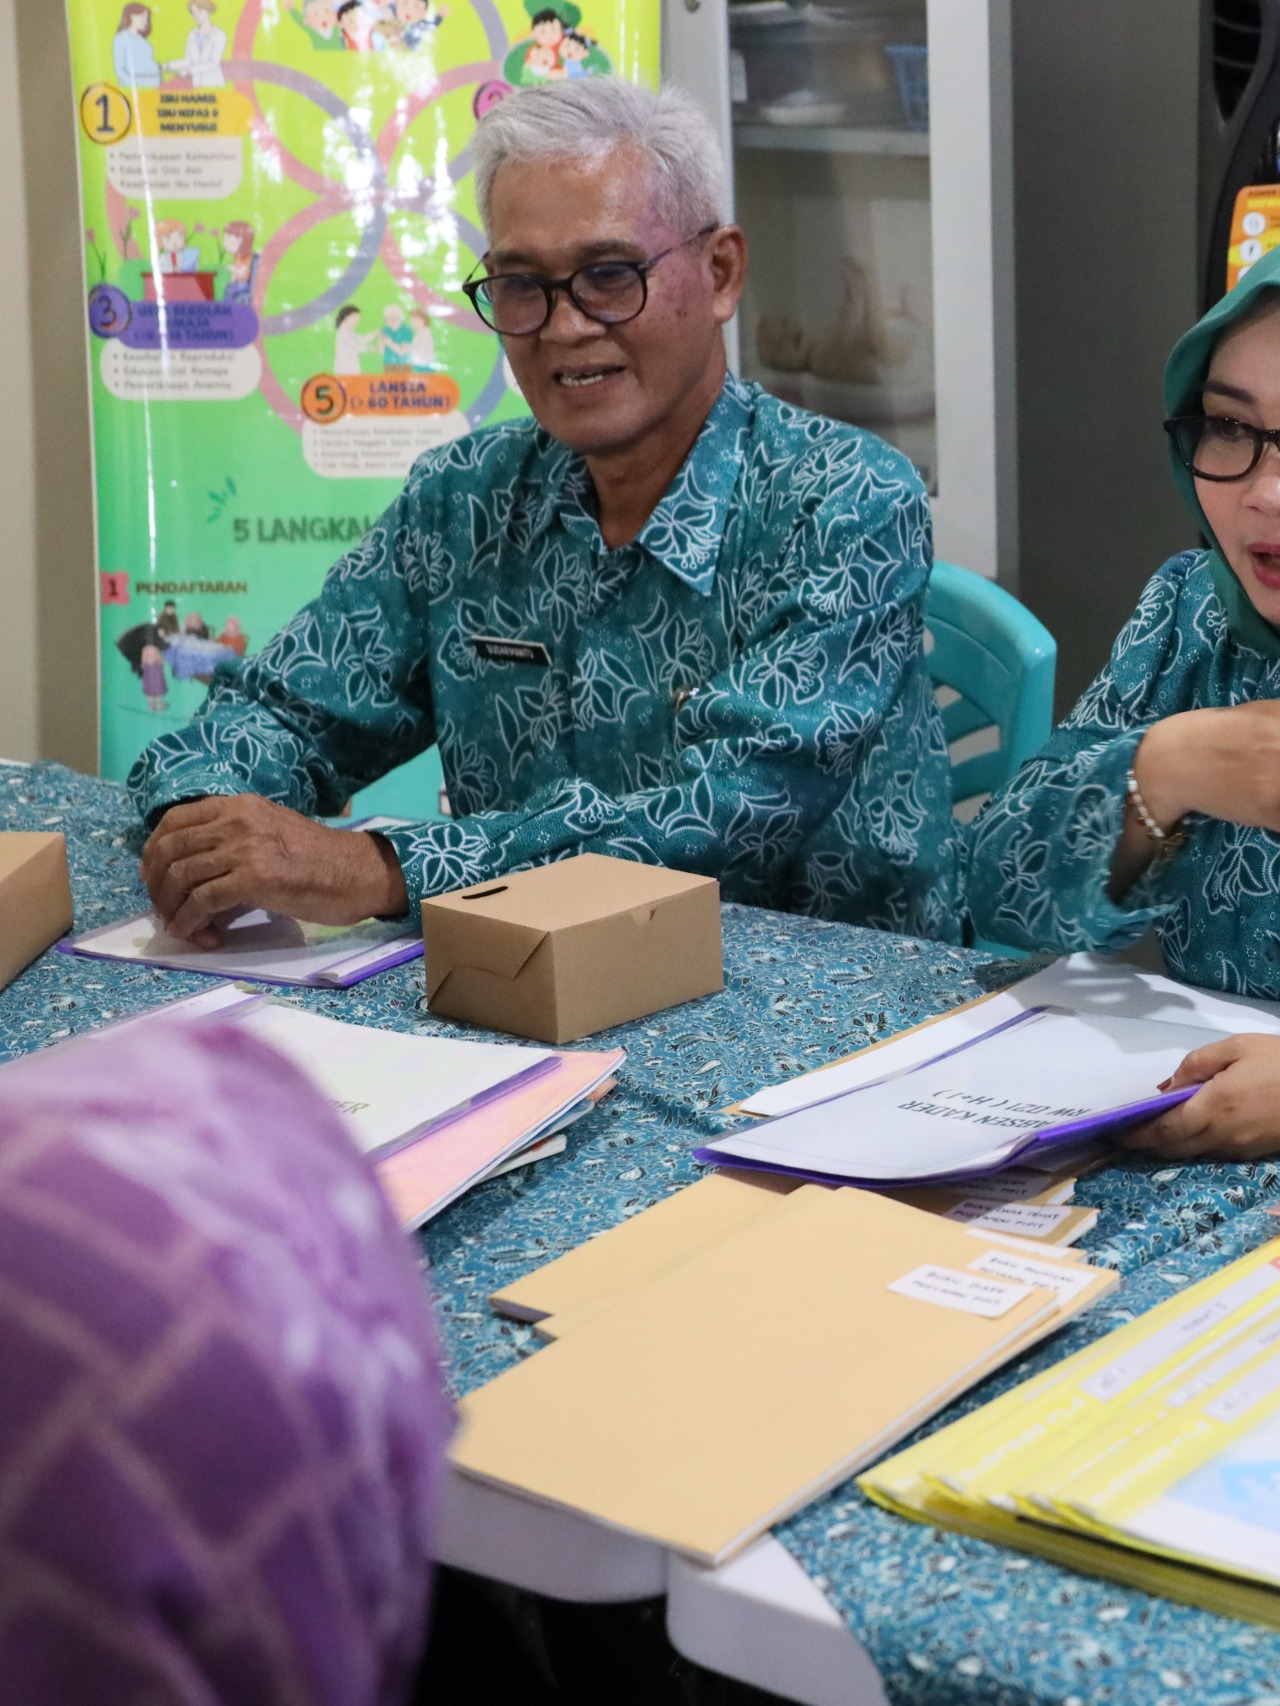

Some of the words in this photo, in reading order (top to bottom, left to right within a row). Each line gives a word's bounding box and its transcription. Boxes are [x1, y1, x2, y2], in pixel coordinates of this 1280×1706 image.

[96, 94, 115, 133] 1
[99, 295, 117, 327] 3
[369, 381, 426, 393] LANSIA
[315, 386, 335, 415] 5
[368, 397, 388, 409] 60
[232, 517, 250, 543] 5
[108, 579, 119, 597] 1
[136, 581, 247, 595] PENDAFTARAN
[897, 1100, 978, 1121] KADER
[1050, 1107, 1093, 1117] RW
[973, 1115, 1057, 1129] ABSEN
